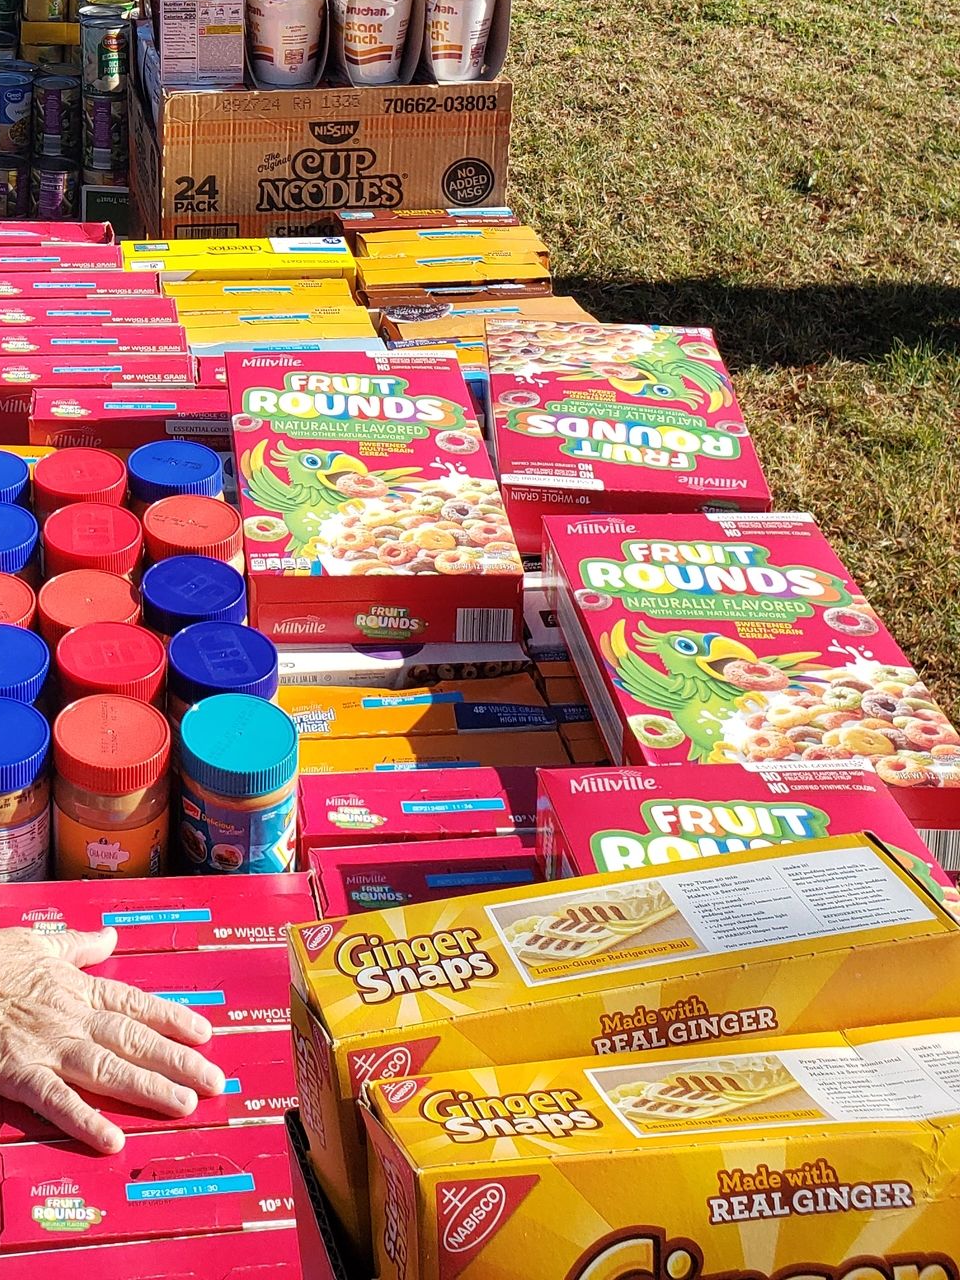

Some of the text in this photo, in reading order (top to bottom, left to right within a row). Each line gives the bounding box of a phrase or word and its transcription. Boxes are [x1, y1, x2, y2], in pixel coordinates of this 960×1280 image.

[293, 97, 312, 111] RA
[384, 95, 497, 114] 70662-03803
[314, 124, 354, 137] NISSIN
[257, 156, 291, 173] Original
[264, 153, 280, 163] The
[293, 150, 375, 179] CUP
[457, 167, 475, 178] NO
[174, 175, 219, 201] 24
[449, 175, 488, 192] ADDED
[258, 175, 401, 211] NOODLES
[457, 186, 482, 200] MSG
[174, 200, 219, 213] PACK
[208, 244, 263, 253] Cheerios
[242, 357, 302, 367] Millville
[291, 375, 397, 395] FRUIT
[248, 391, 446, 421] ROUNDS
[570, 400, 602, 408] FLAVORS
[551, 404, 703, 427] NATURALLY FLAVORED
[274, 421, 422, 435] NATURALLY FLAVORED
[526, 415, 733, 456] ROUNDS
[45, 434, 102, 448] Millville
[574, 440, 690, 468] FRUIT
[578, 462, 592, 471] NO
[579, 470, 594, 479] NO
[678, 475, 748, 488] Millville
[511, 492, 573, 504] WHOLE GRAIN
[567, 523, 636, 535] Millville
[724, 529, 742, 538] NO
[630, 543, 755, 563] FRUIT
[586, 562, 826, 595] ROUNDS
[371, 606, 406, 616] FRUIT
[627, 597, 806, 613] NATURALLY FLAVORED
[273, 618, 326, 634] Millville
[356, 615, 419, 630] ROUNDS
[760, 772, 782, 781] NO
[569, 776, 657, 794] Millville
[767, 783, 790, 793] NO
[325, 798, 365, 806] Millville
[202, 815, 235, 830] Delicious
[328, 813, 378, 822] ROUNDS
[650, 805, 810, 835] FRUIT
[346, 875, 387, 884] Millville
[352, 891, 403, 901] ROUNDS
[721, 886, 750, 894] Servings
[22, 911, 63, 921] Millville
[233, 927, 276, 937] WHOLE
[309, 925, 333, 951] NABISCO
[338, 928, 479, 974] Ginger
[535, 941, 690, 975] Lemon-Ginger Refrigerator Roll
[356, 953, 493, 1003] Snaps
[250, 1009, 291, 1019] WHOLE
[603, 999, 706, 1033] Made with
[594, 1009, 776, 1055] REAL GINGER
[391, 1080, 414, 1102] NABISCO
[423, 1090, 580, 1118] Ginger
[442, 1109, 599, 1143] Snaps
[644, 1110, 814, 1130] Lemon-Ginger Refrigerator Roll
[719, 1162, 836, 1193] Made with
[31, 1183, 79, 1197] Millville
[47, 1199, 81, 1208] FRUIT
[711, 1183, 914, 1222] REAL GINGER
[33, 1208, 96, 1219] ROUNDS
[447, 1188, 500, 1249] NABISCO
